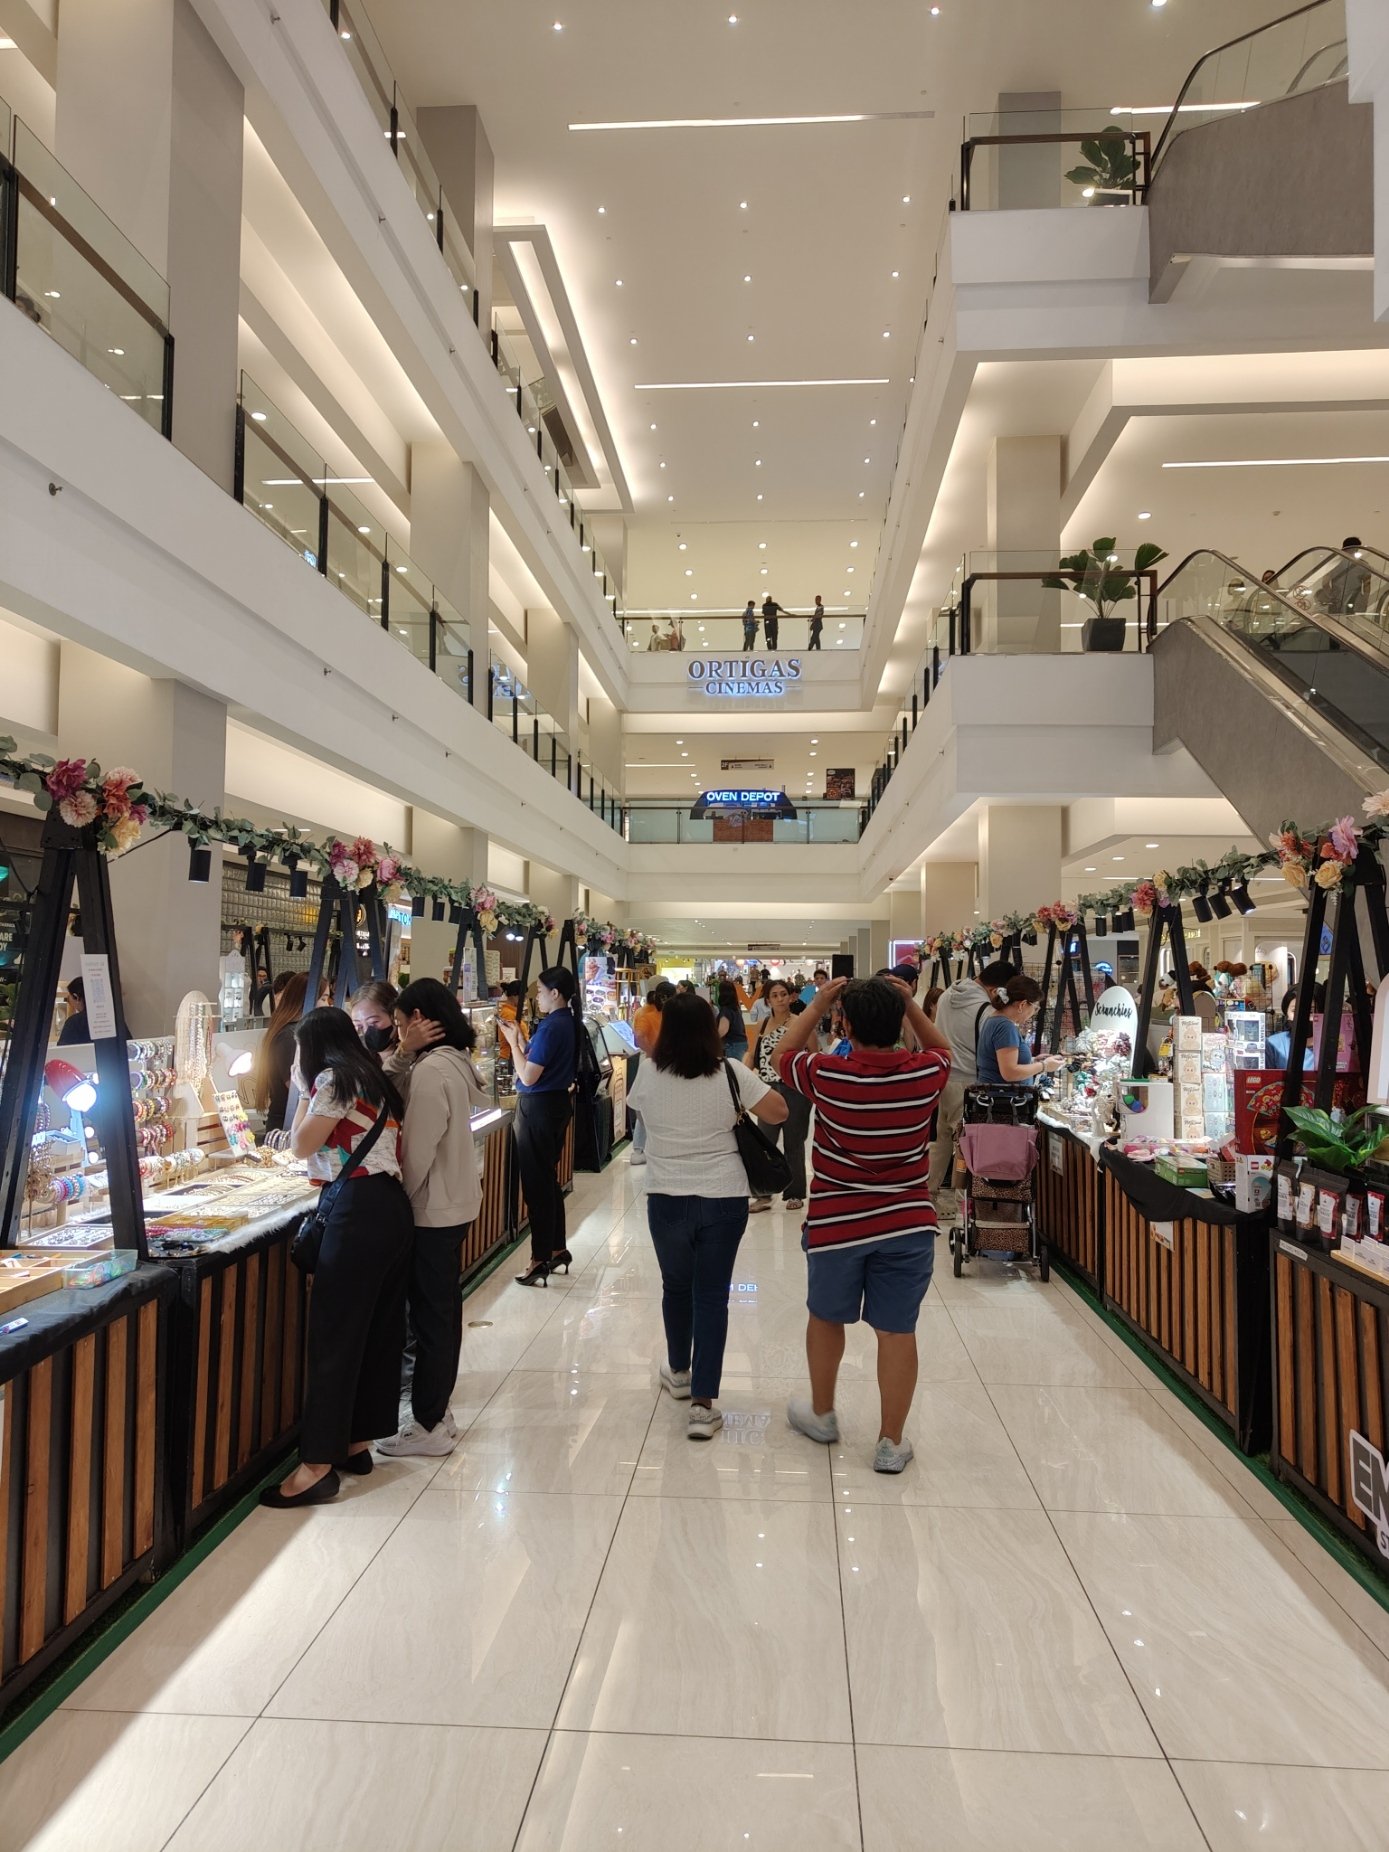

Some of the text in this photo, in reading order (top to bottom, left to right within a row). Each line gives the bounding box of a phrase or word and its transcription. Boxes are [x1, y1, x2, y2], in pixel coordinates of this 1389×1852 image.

[688, 658, 801, 679] ORTIGAS
[705, 681, 784, 694] CINEMAS
[706, 791, 781, 801] OVEN DEPOT
[1094, 1001, 1133, 1018] Scrunchies
[1246, 1076, 1262, 1084] LEGO
